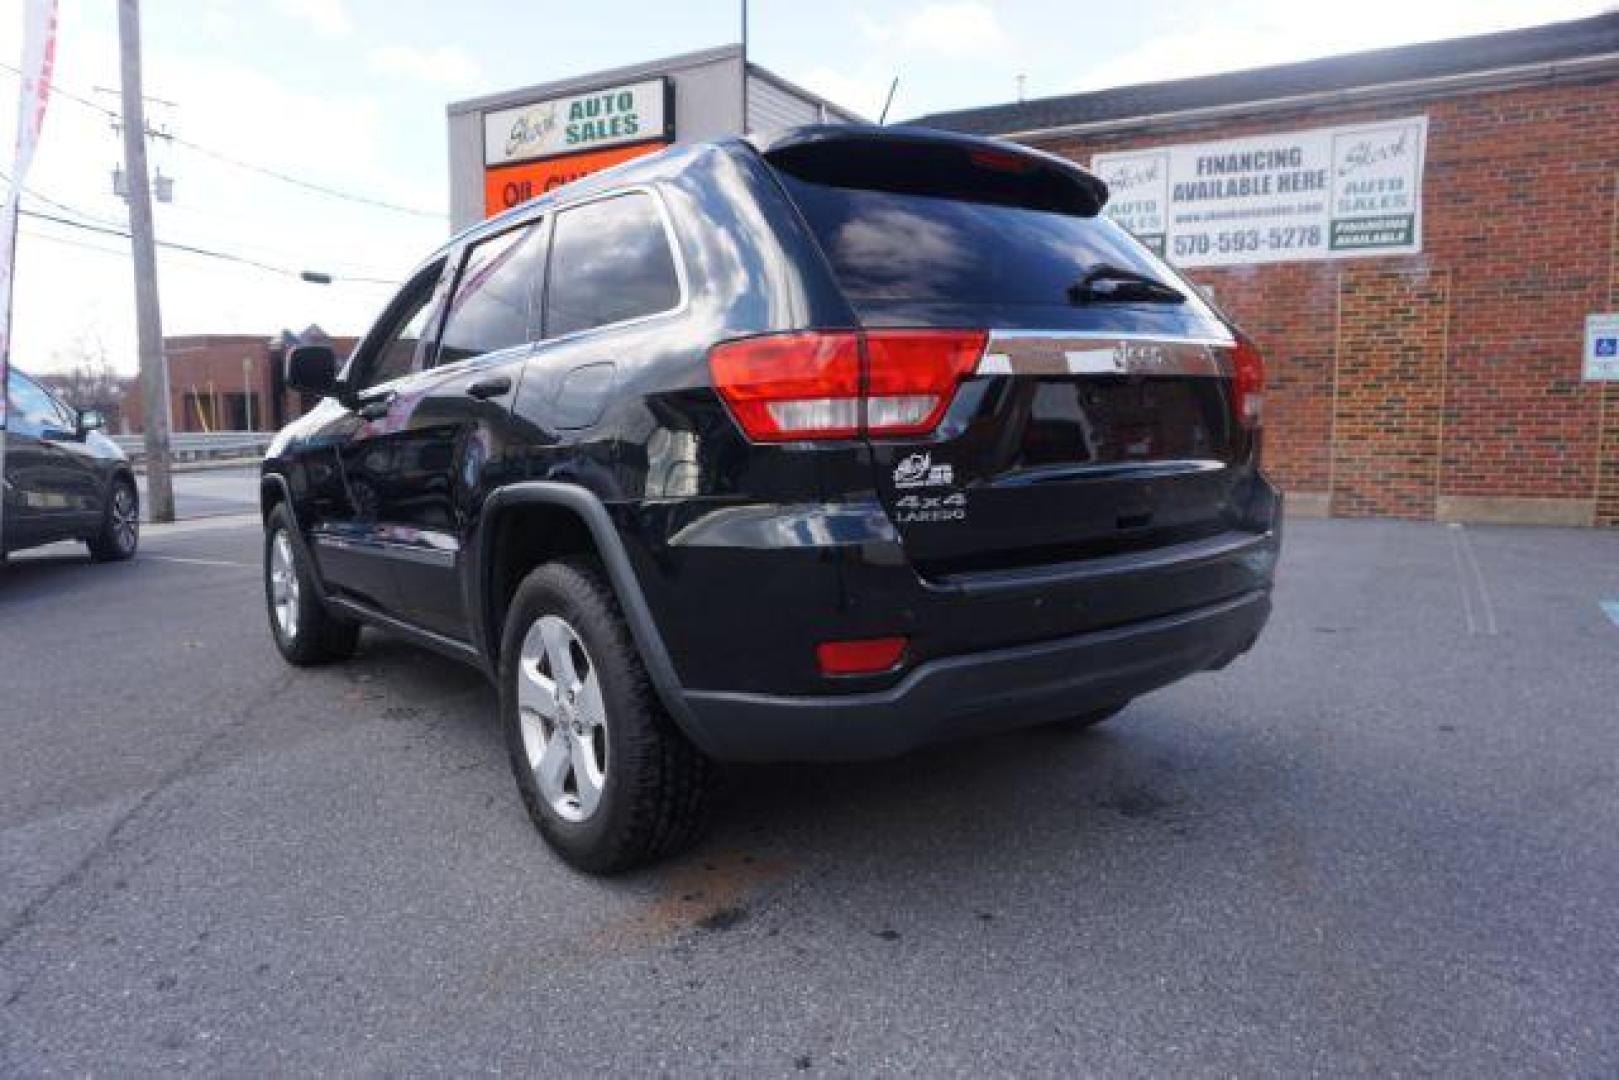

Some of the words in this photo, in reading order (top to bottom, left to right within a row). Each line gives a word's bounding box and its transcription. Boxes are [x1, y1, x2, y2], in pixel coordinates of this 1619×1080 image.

[569, 91, 633, 121] AUTO
[566, 113, 639, 144] SALES
[1196, 147, 1302, 176] FINANCING
[1173, 173, 1273, 202] AVAILABLE
[1276, 168, 1328, 193] HERE
[1345, 177, 1405, 194] AUTO
[1174, 225, 1322, 257] 570-593-5278
